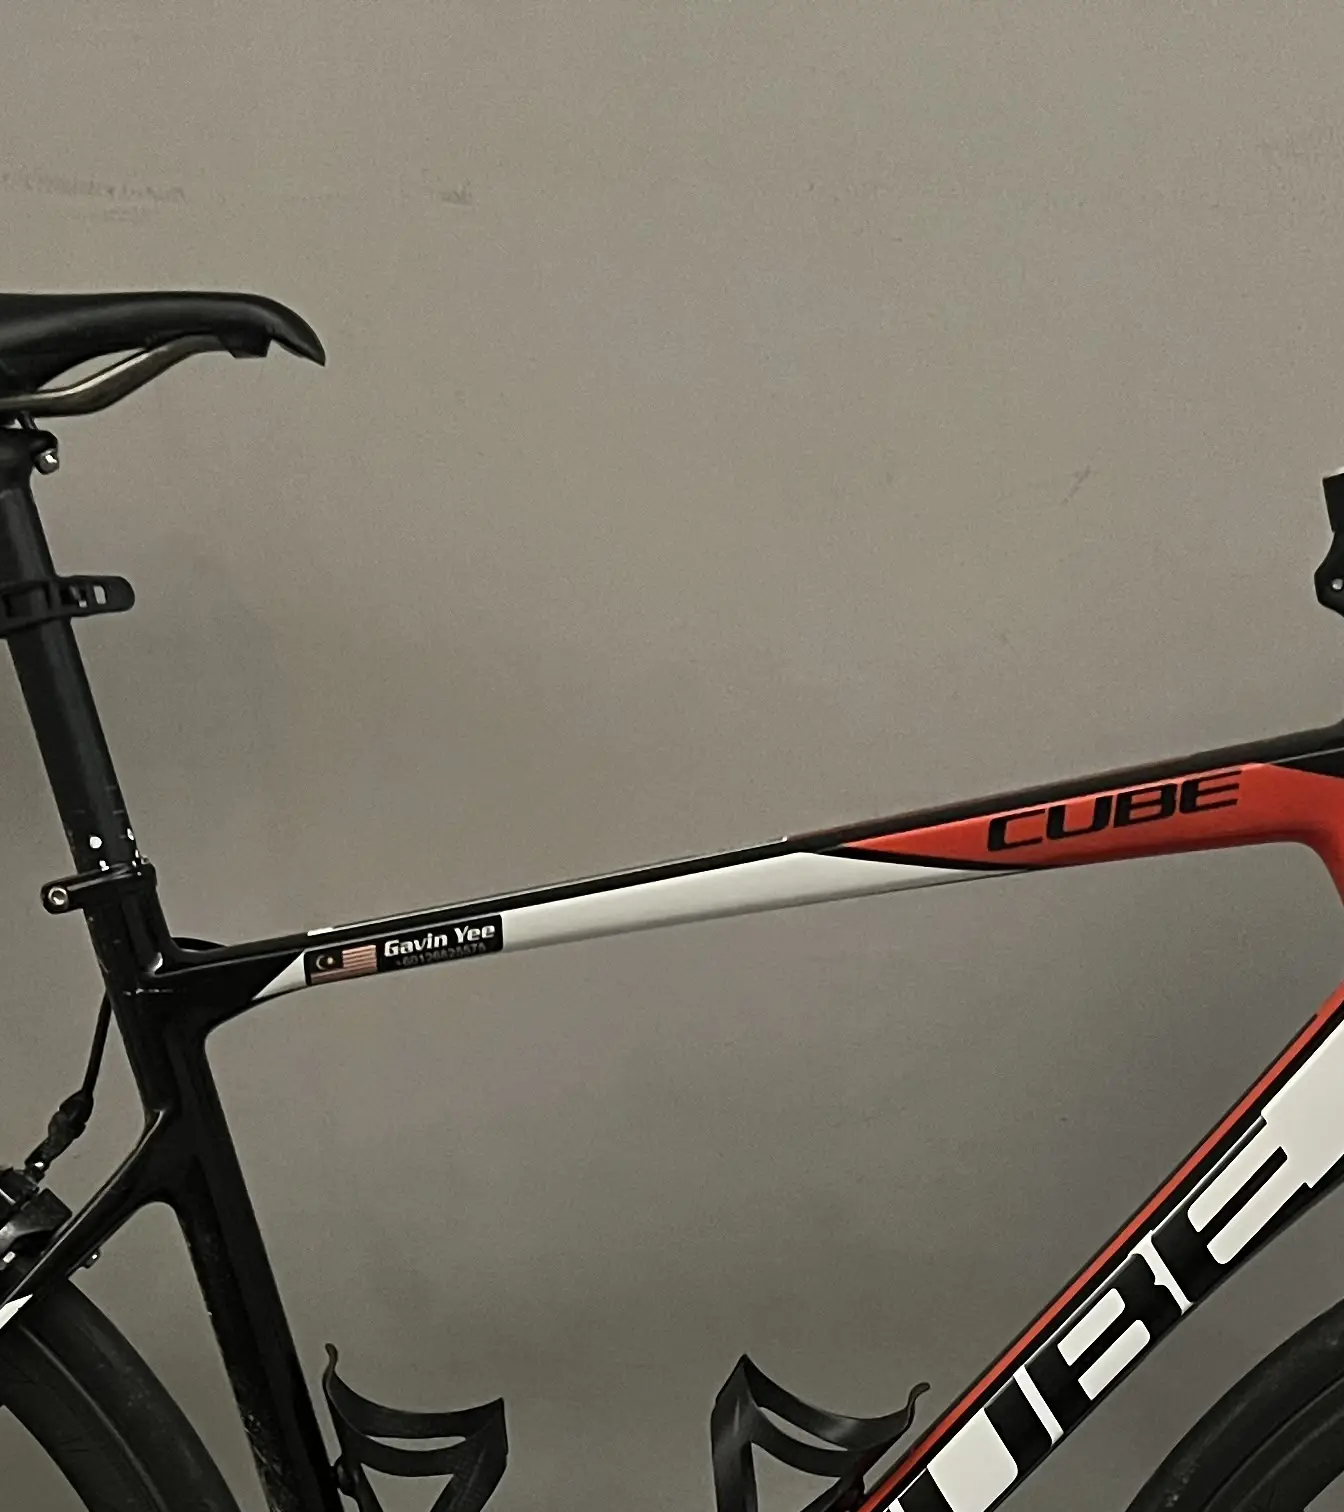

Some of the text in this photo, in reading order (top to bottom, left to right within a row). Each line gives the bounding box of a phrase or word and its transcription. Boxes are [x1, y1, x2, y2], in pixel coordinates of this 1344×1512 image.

[987, 769, 1242, 852] CUBE
[384, 925, 496, 957] Gavin Yee
